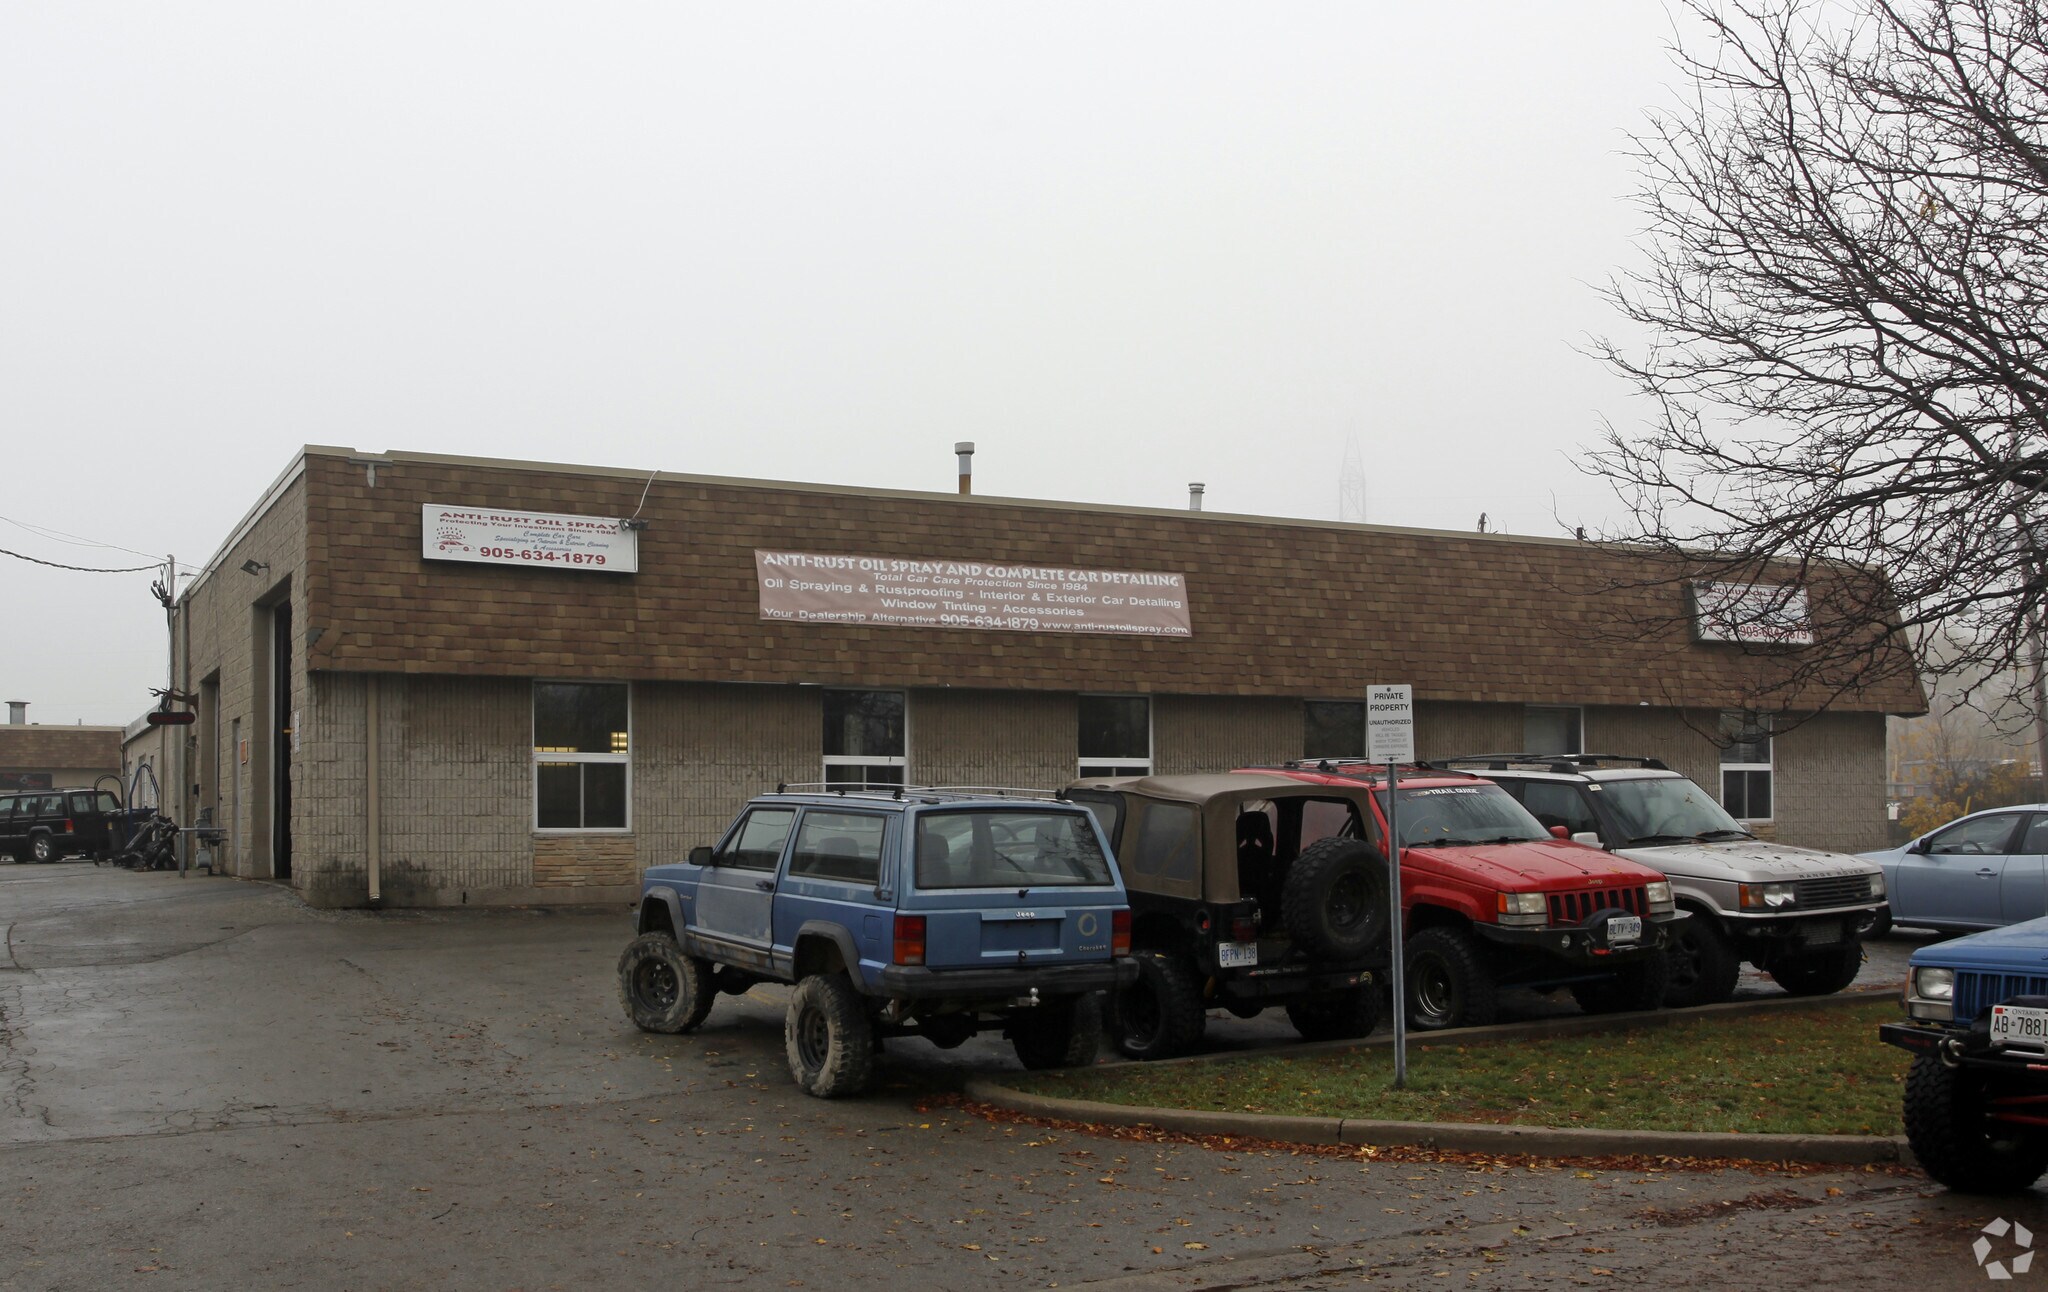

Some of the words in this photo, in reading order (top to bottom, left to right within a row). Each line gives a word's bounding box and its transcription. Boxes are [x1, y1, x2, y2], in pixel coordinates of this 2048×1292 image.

[440, 512, 531, 524] ANTI-RUST
[535, 518, 562, 527] OIL
[566, 521, 619, 530] SPRAY
[440, 518, 488, 527] Protecting
[514, 524, 565, 532] Investment
[480, 546, 606, 565] 905-634-1879
[763, 553, 855, 570] ANTI-RUST
[859, 558, 888, 572] OIL
[890, 560, 943, 575] SPRAY
[946, 563, 982, 577] AND
[985, 566, 1064, 581] COMPLETE
[1068, 570, 1099, 583] CAR
[1101, 572, 1179, 587] DETAILING
[873, 572, 902, 582] Total
[907, 574, 928, 583] Car
[932, 575, 960, 585] Care
[964, 577, 1022, 588] Protection
[1026, 580, 1058, 590] Since
[1062, 582, 1088, 591] 1984
[764, 578, 783, 588] Oil
[788, 579, 853, 593] Spraying
[858, 583, 869, 593] &
[874, 584, 964, 599] Rustproofing
[979, 590, 1026, 602] Interior
[1031, 592, 1041, 602] &
[1046, 593, 1097, 604] Exterior
[1101, 595, 1124, 605] Car
[1129, 597, 1182, 609] Detailing
[880, 598, 937, 610] Window
[942, 601, 987, 614] Tinting
[1002, 604, 1085, 617] Accessories
[764, 608, 793, 618] Your
[798, 609, 867, 622] Dealership
[872, 612, 936, 625] Alternative
[940, 613, 1039, 629] 905-634-1879
[1041, 622, 1188, 634] www.anti-rustoilspray.com
[1374, 692, 1404, 700] PRIVATE
[1369, 703, 1410, 711] PROPERTY
[1078, 944, 1107, 952] Cherokee
[1993, 1016, 2009, 1033] AB
[2017, 1017, 2048, 1037] 7881
